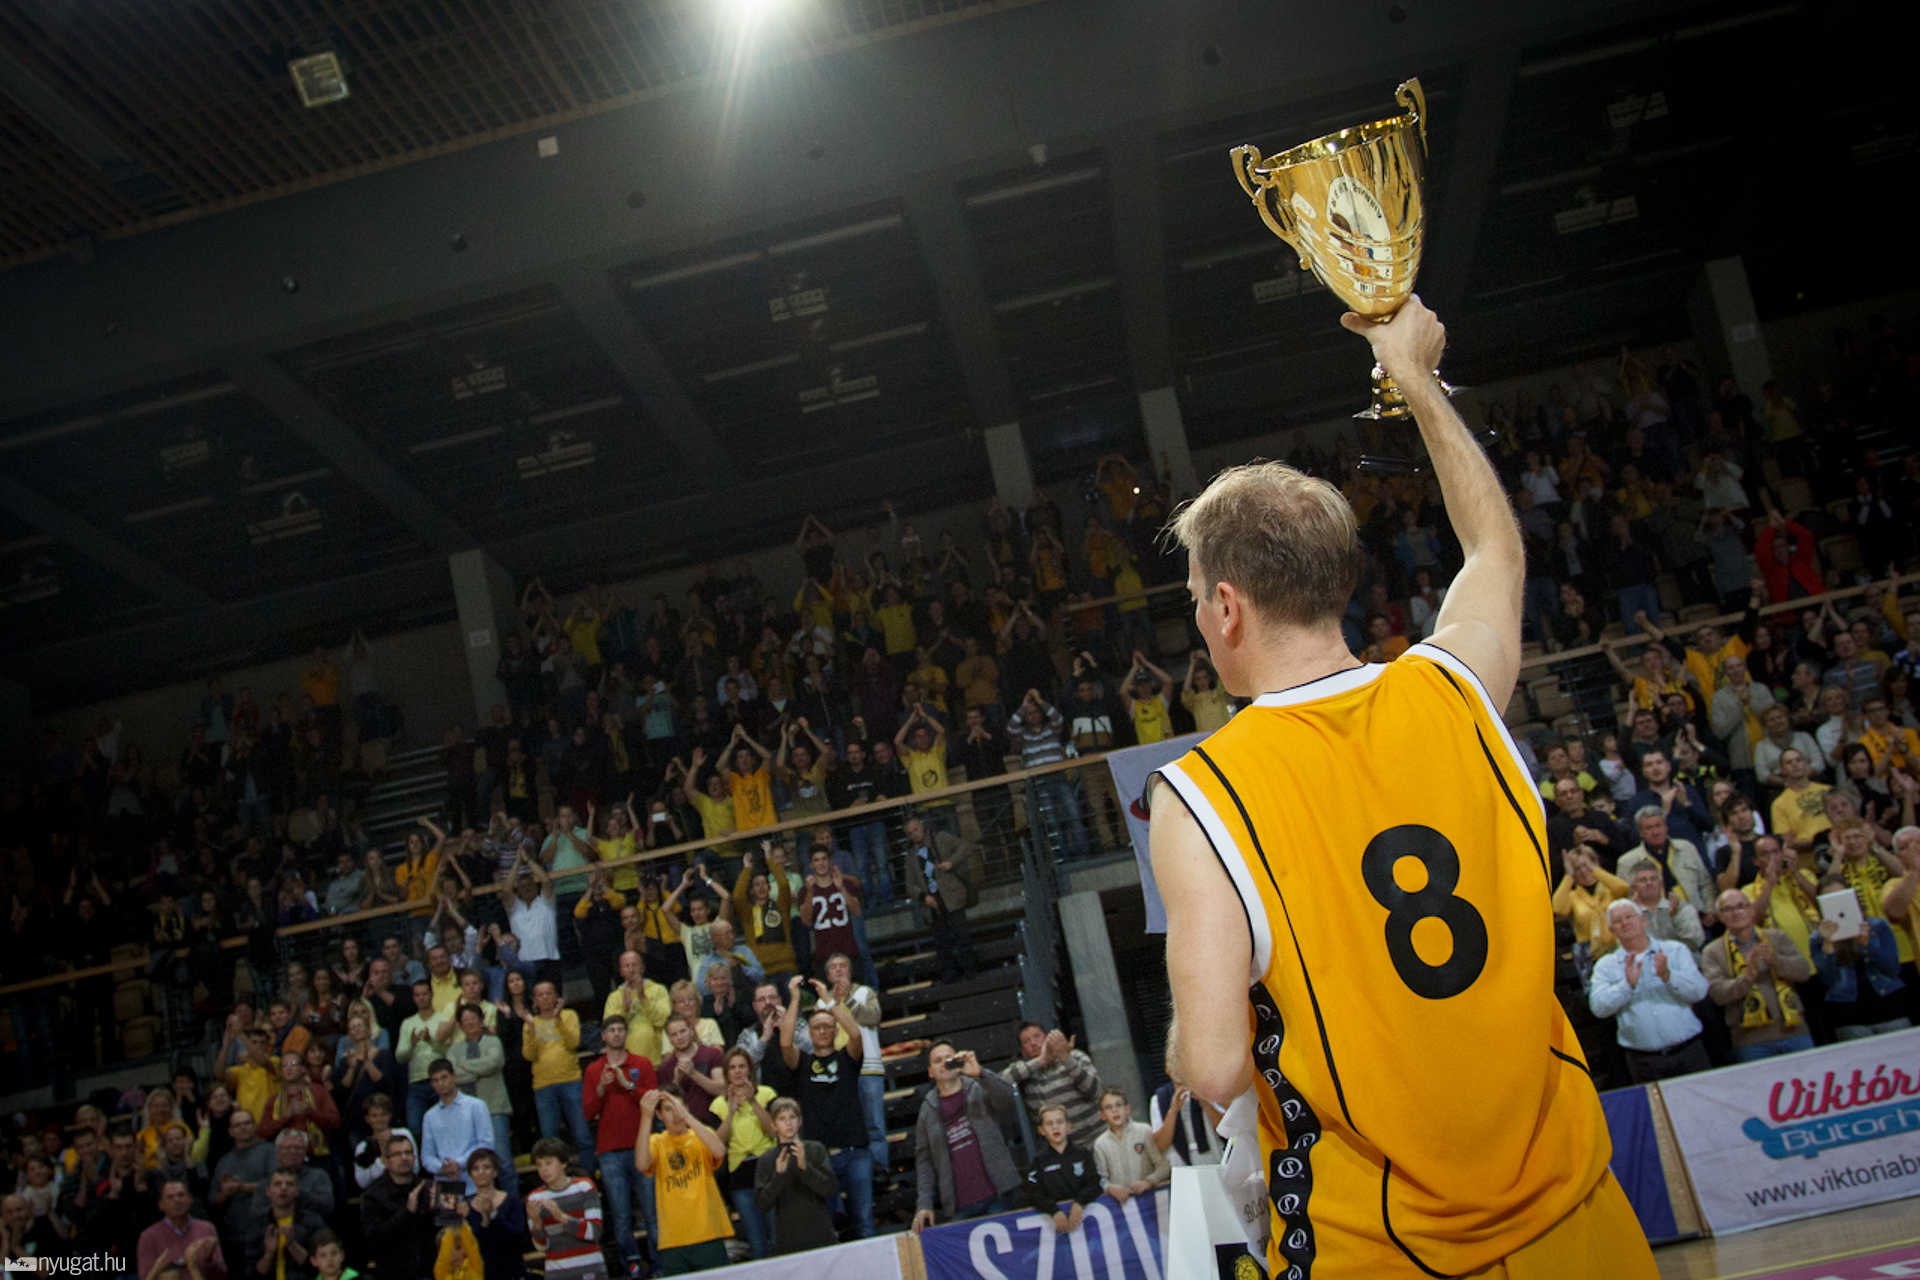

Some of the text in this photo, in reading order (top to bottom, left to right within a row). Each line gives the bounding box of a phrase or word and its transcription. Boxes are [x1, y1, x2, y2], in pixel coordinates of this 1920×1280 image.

[812, 892, 850, 931] 23
[1361, 823, 1489, 1000] 8
[1768, 1064, 1920, 1122] Viktór
[1745, 1153, 1920, 1208] www.viktoriab
